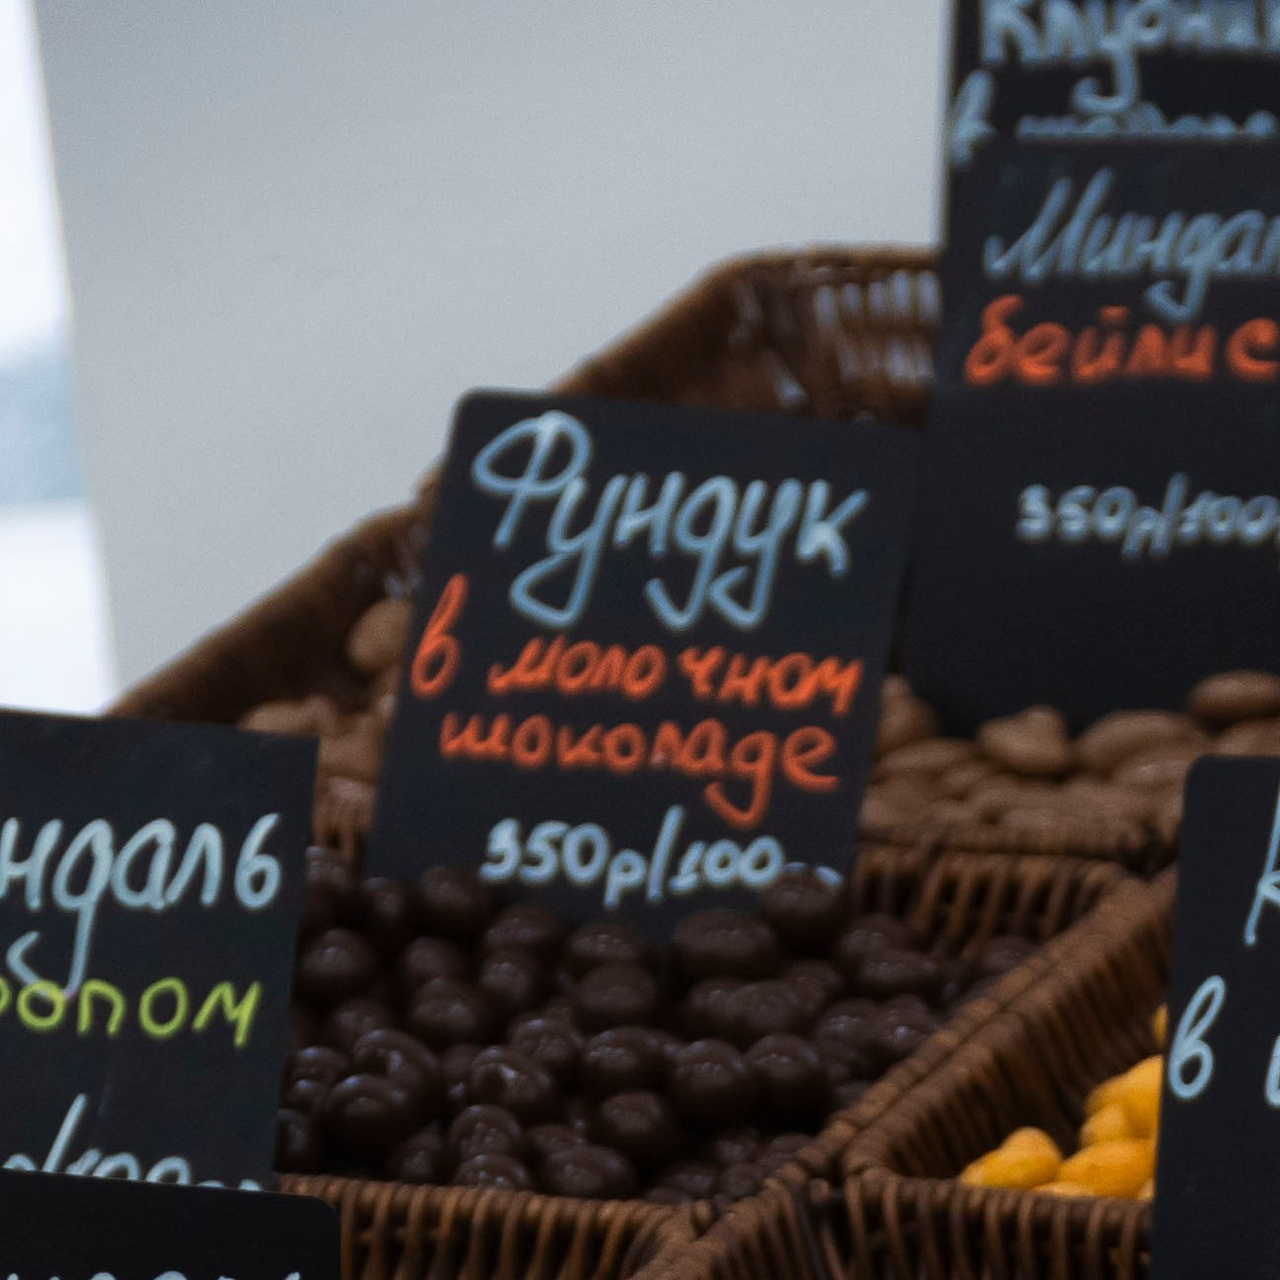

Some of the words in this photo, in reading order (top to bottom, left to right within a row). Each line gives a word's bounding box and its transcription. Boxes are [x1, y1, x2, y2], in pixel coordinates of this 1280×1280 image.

[963, 294, 1280, 386] бейлис
[470, 410, 870, 628] Фундук
[410, 573, 468, 698] в
[438, 712, 841, 829] шоколаде
[1167, 974, 1226, 1099] в
